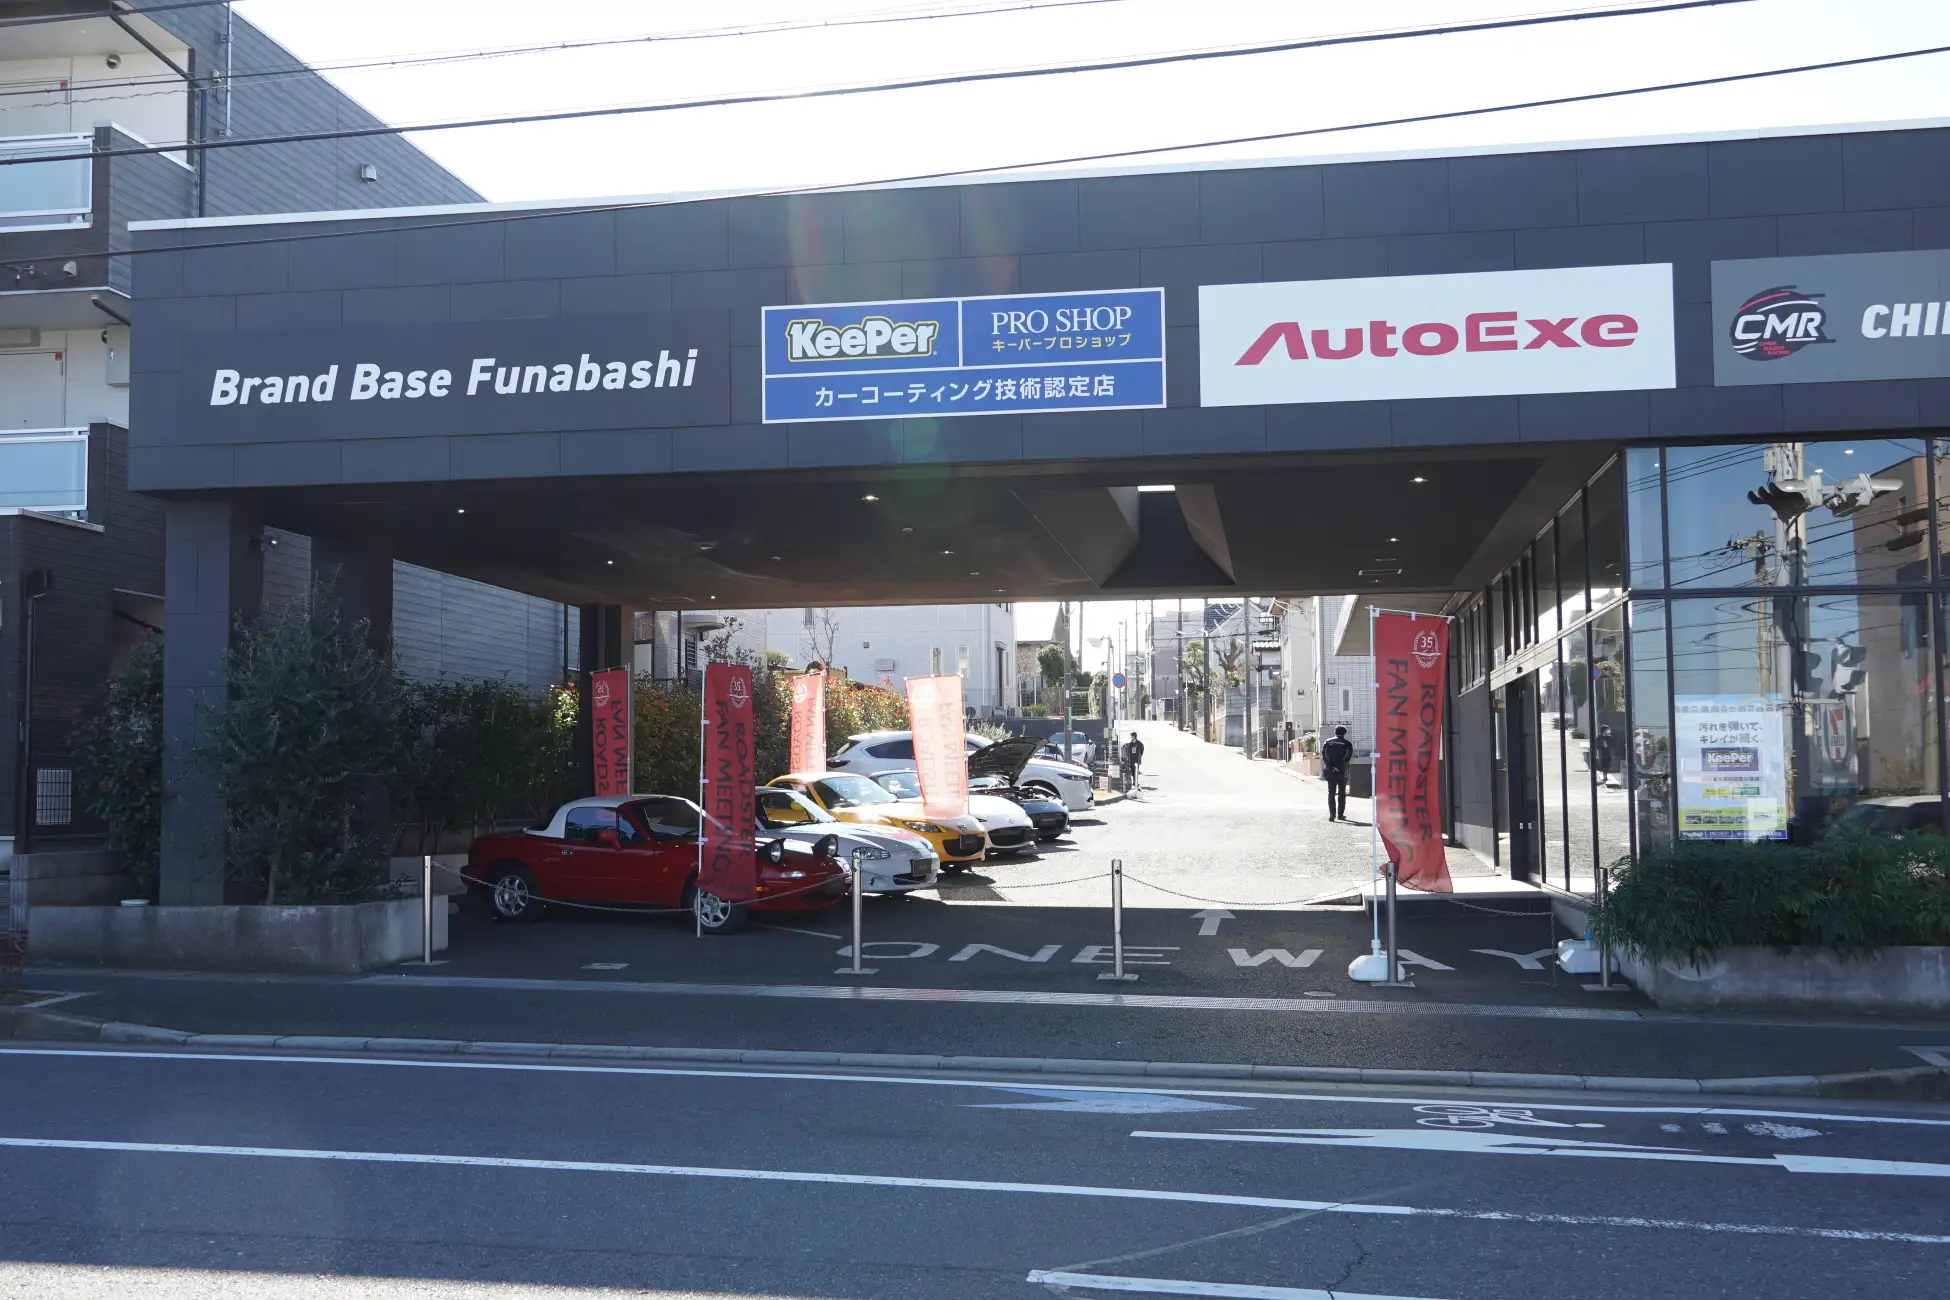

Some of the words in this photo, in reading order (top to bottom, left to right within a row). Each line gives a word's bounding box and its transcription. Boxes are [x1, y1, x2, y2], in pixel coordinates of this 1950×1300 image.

[991, 309, 1049, 335] PRO
[1055, 306, 1132, 333] SHOP
[1734, 312, 1822, 340] CMR
[1861, 301, 1950, 339] CHI
[787, 318, 937, 360] KeePer
[992, 333, 1132, 353] キーパープロショップ
[1234, 311, 1639, 366] AutoExe
[210, 364, 338, 406] Brand
[350, 363, 452, 401] Base
[466, 348, 699, 396] Funabashi
[814, 374, 1115, 407] カーコーティング技術認定店
[1420, 636, 1433, 648] 35
[733, 680, 741, 691] 35
[1387, 658, 1409, 717] FAN
[715, 700, 731, 749] FAN
[1698, 720, 1763, 732] 汚れを弾いて、
[1413, 683, 1437, 841] ROADSTER
[1707, 751, 1753, 763] KeePer
[734, 722, 753, 859] ROADSTER
[713, 758, 733, 873] MEETING
[835, 940, 1181, 965] ONE
